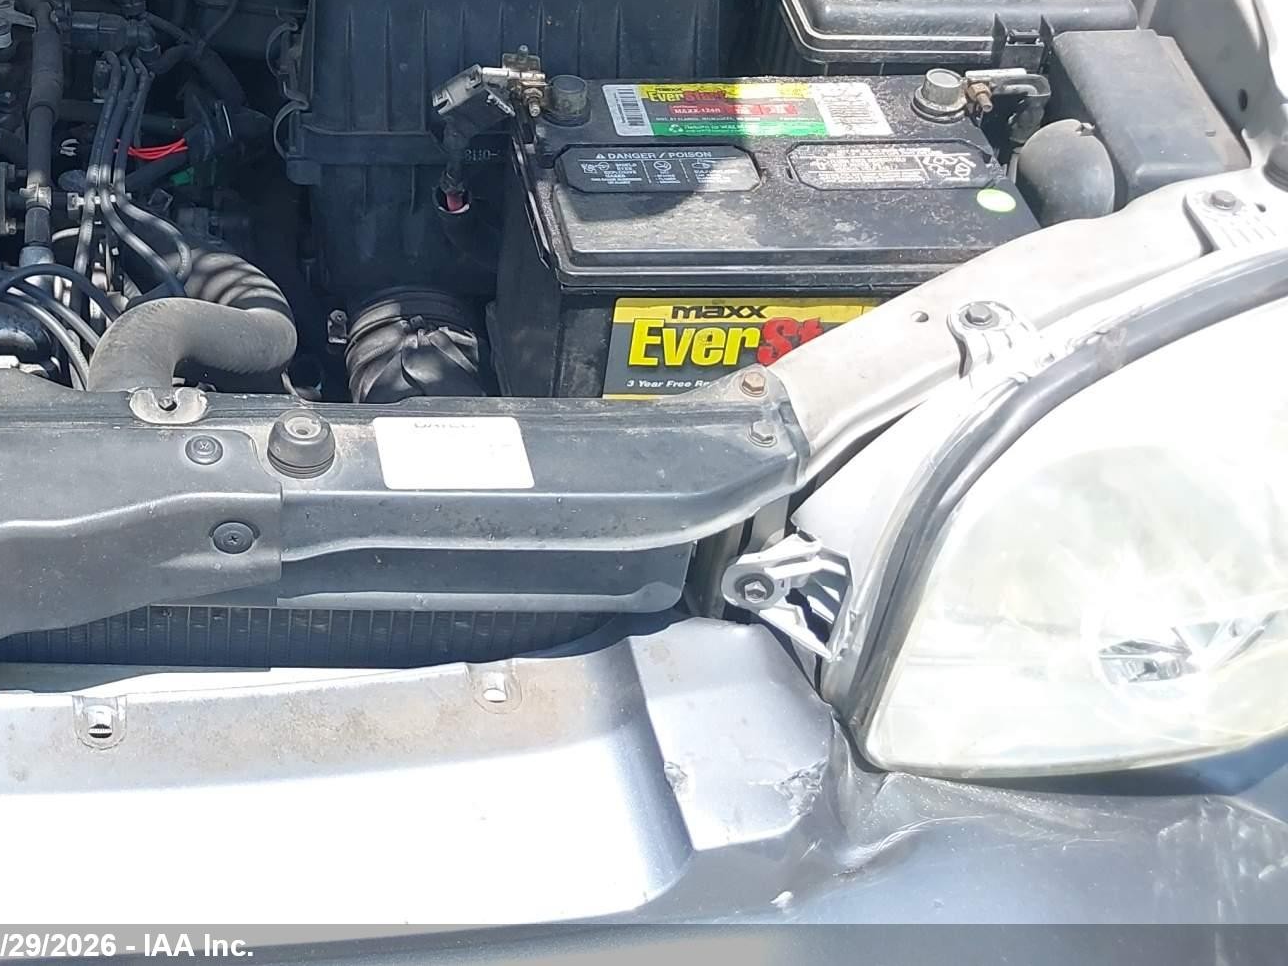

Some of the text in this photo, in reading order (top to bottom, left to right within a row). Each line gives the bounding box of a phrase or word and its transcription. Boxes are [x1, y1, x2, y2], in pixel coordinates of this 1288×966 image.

[608, 152, 656, 160] DANGER
[668, 151, 712, 159] POISON
[671, 305, 769, 319] maxx
[626, 379, 635, 387] 3
[638, 379, 664, 388] Year
[665, 379, 692, 388] Free
